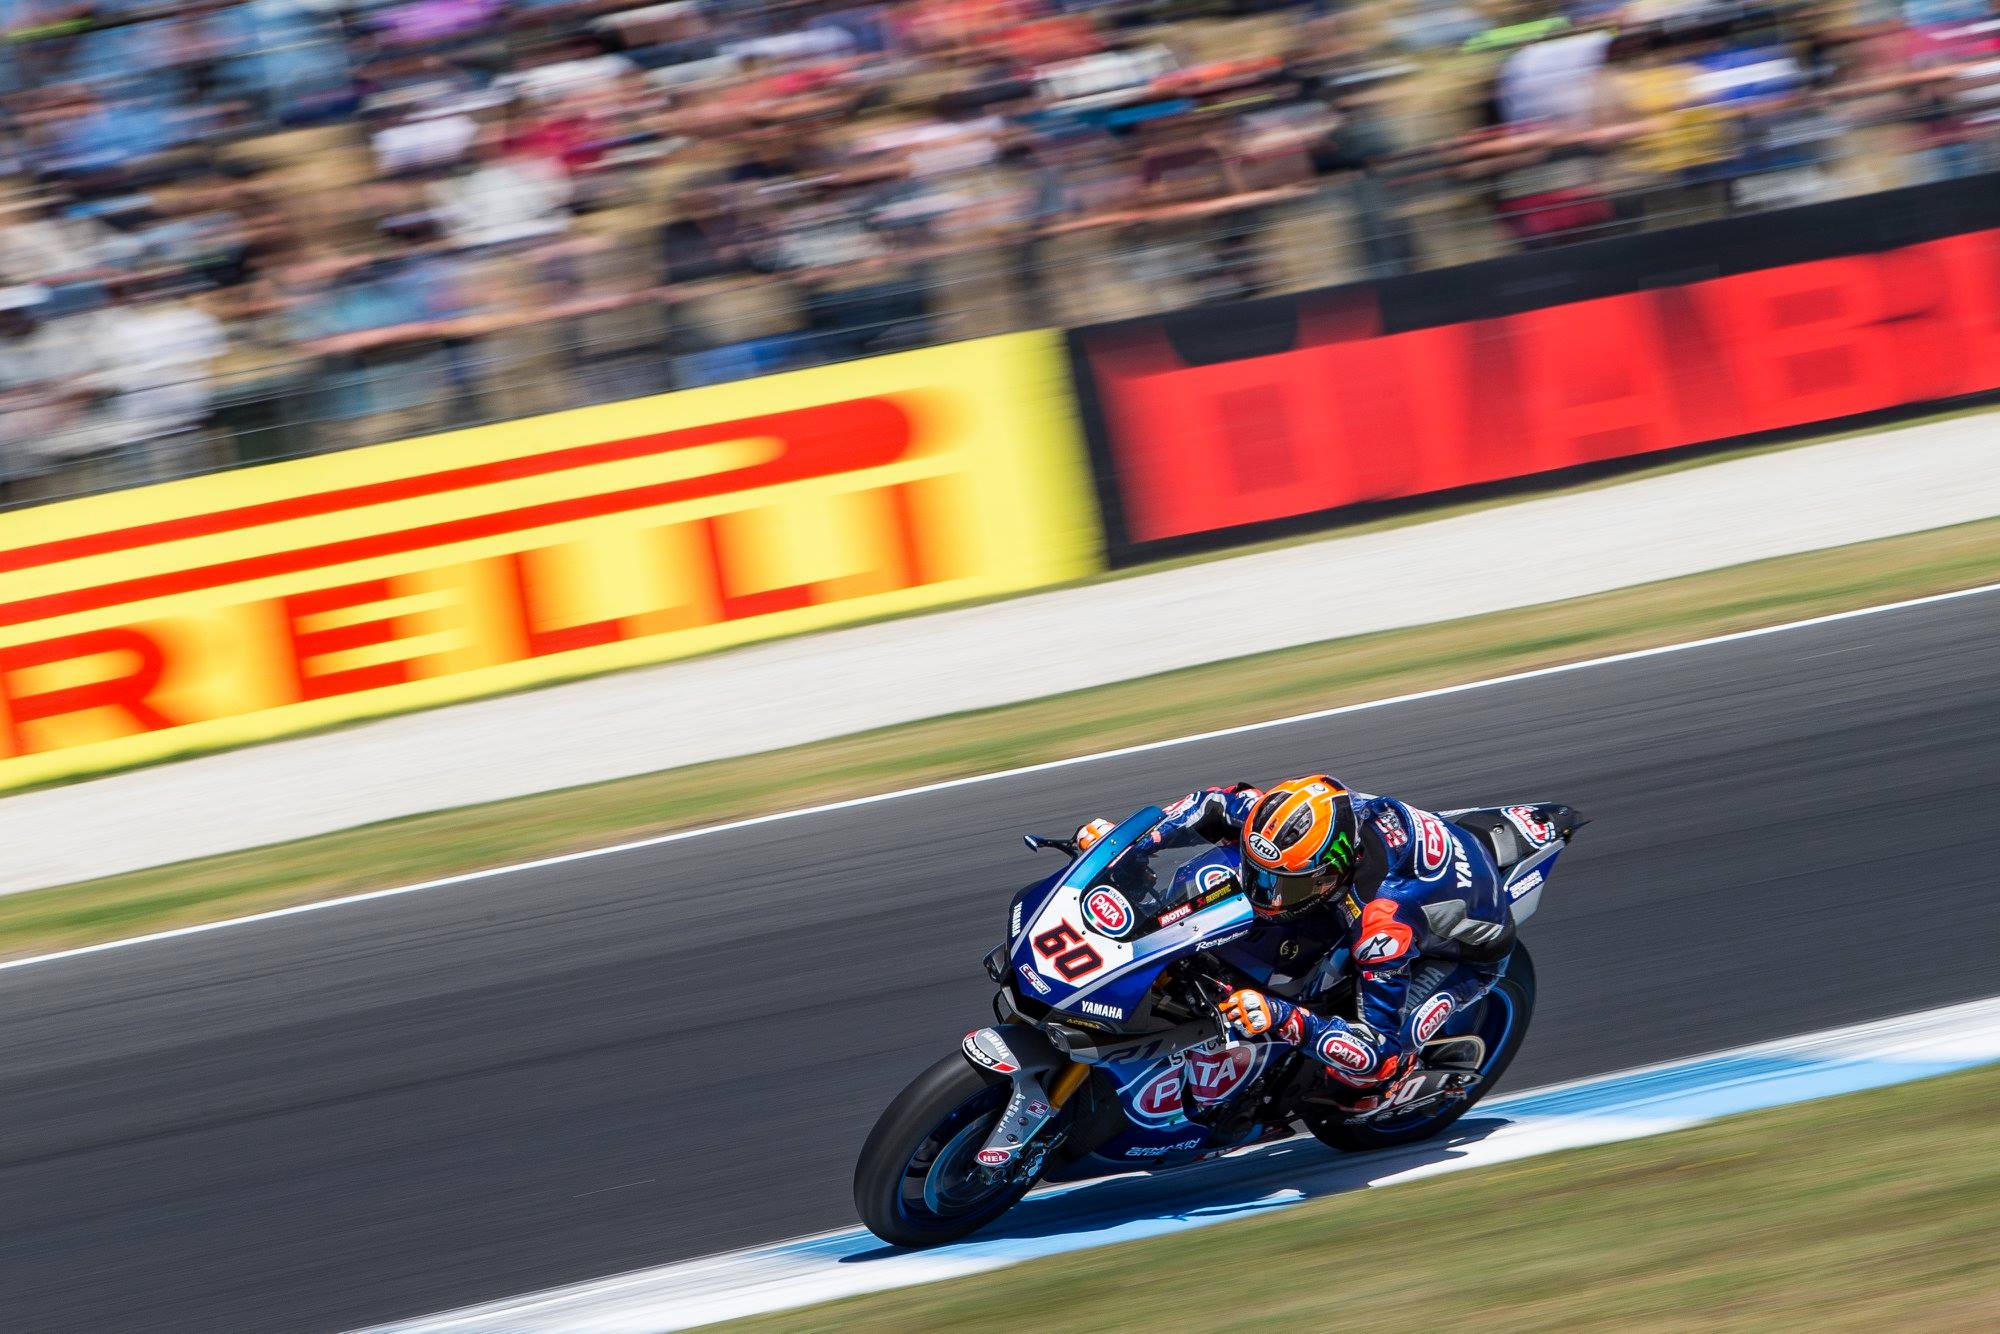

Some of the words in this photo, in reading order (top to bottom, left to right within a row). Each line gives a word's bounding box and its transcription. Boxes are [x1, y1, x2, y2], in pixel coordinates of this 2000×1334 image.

[1251, 837, 1280, 859] Arai
[1090, 896, 1120, 926] PATA
[1107, 889, 1128, 909] SNACK
[1161, 906, 1192, 925] MOTUL
[1033, 917, 1103, 982] 60
[1081, 1000, 1123, 1020] YAMAHA
[1421, 1008, 1447, 1037] PATA
[981, 1031, 1010, 1060] YAMAHA
[1329, 1042, 1363, 1067] PATA
[1153, 1057, 1237, 1108] PATA
[983, 1154, 1006, 1162] HEL
